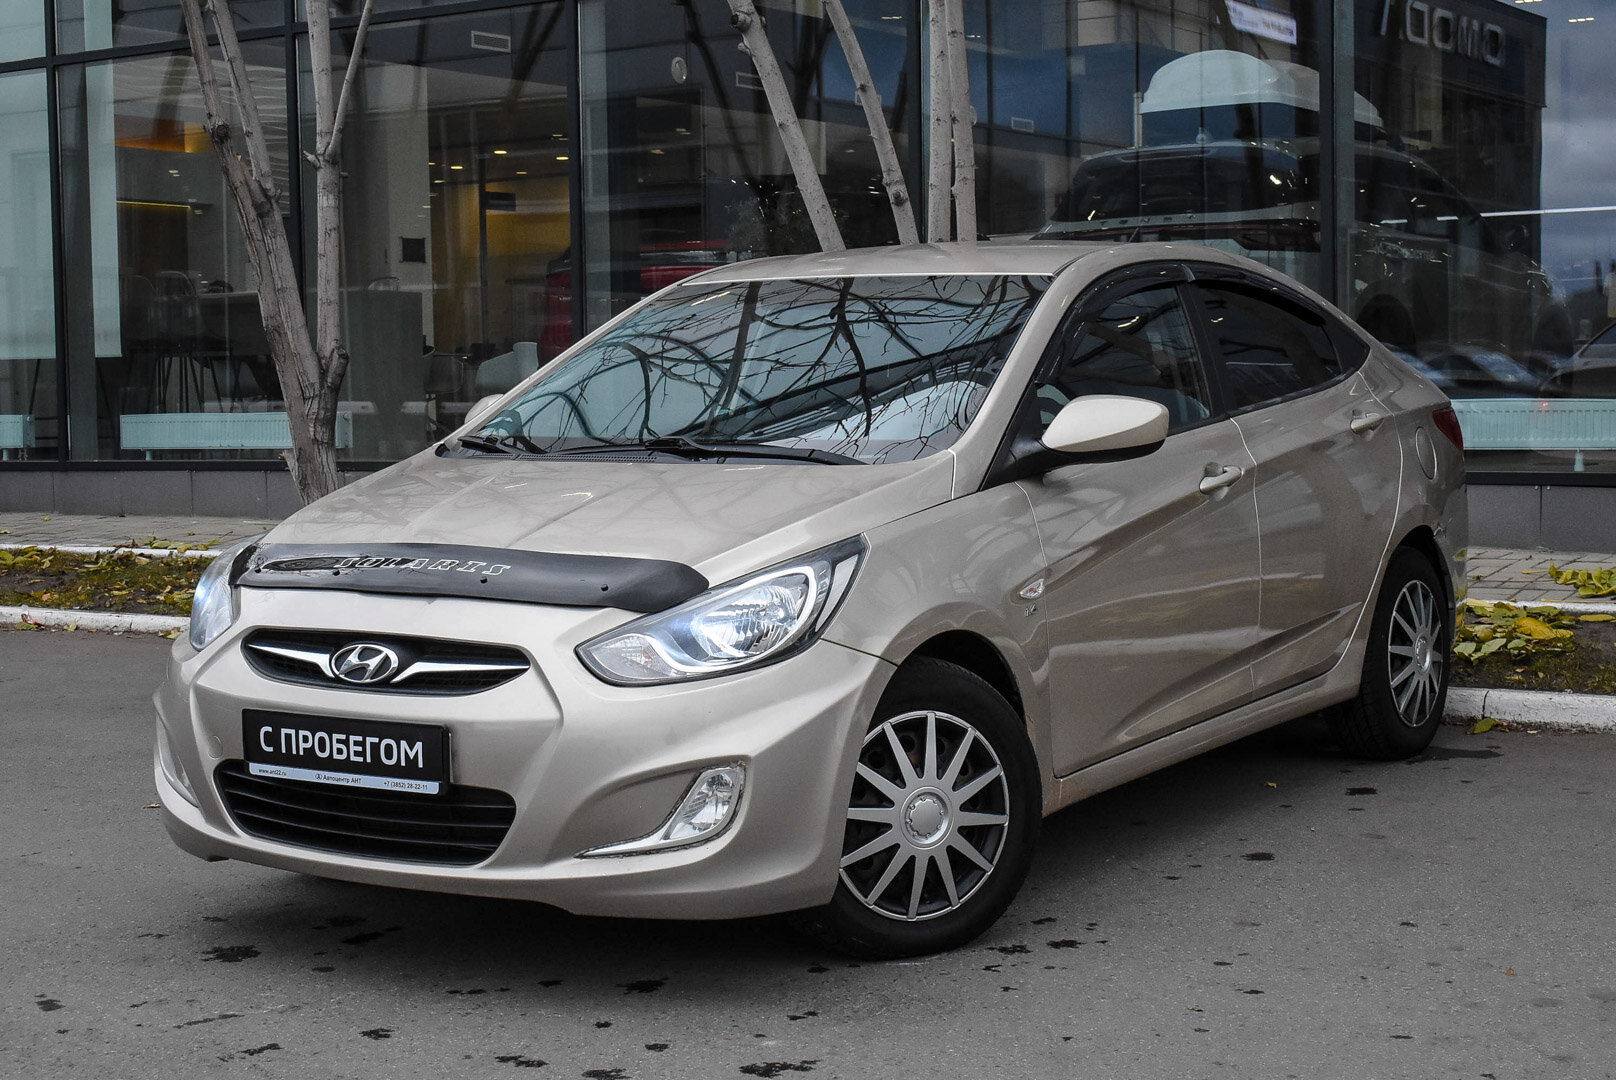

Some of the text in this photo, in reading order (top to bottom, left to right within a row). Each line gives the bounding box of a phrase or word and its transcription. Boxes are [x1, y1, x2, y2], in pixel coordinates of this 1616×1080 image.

[333, 557, 512, 577] SOLARIS
[259, 726, 424, 768] С ПРОБЕГОМ
[258, 768, 287, 777] www.ant22.ru
[322, 773, 362, 784] Автоцентр АНТ
